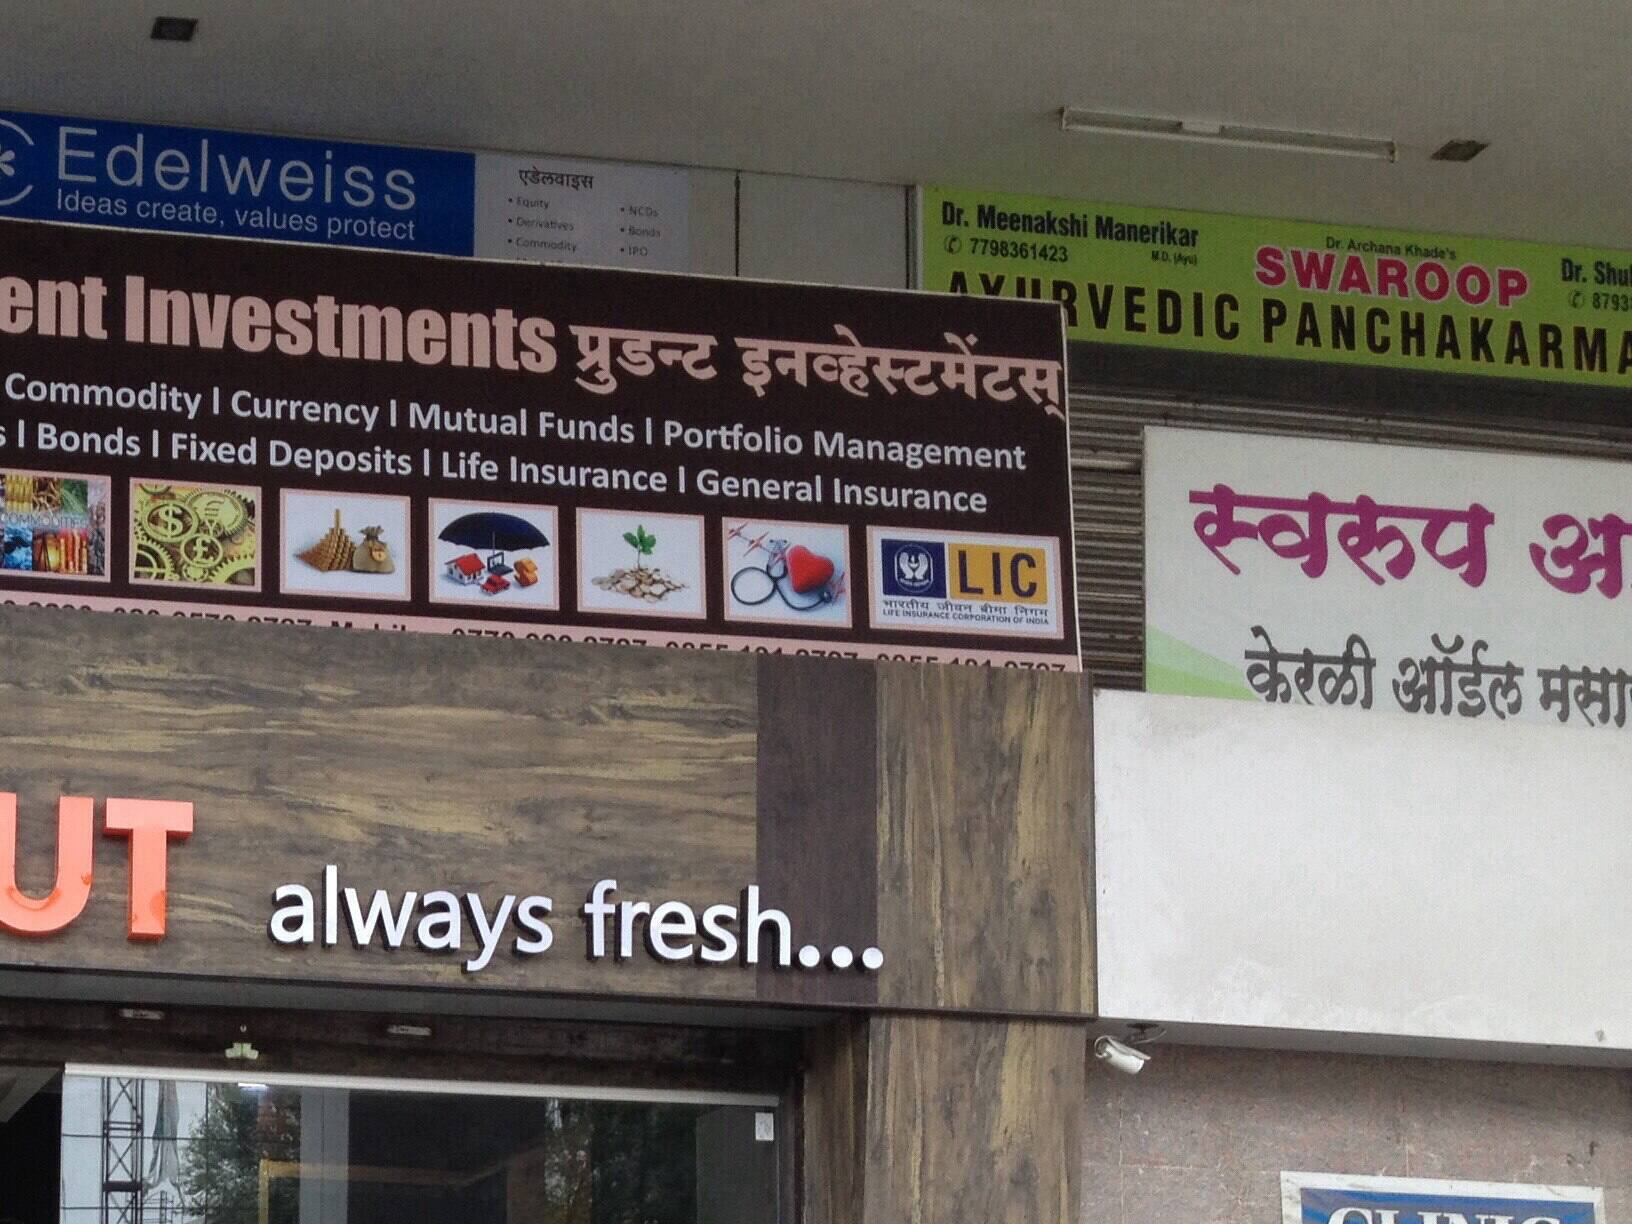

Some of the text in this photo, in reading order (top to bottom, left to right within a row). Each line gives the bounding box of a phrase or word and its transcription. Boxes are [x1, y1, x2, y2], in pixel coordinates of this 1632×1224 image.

[57, 126, 417, 211] Edelweiss
[519, 166, 594, 191] एडेलवाइस
[57, 188, 416, 242] Ideas create, values protect
[517, 197, 550, 209] Equity
[628, 206, 659, 218] NCDs
[517, 217, 574, 231] Derivatives
[628, 226, 661, 238] Bonds
[942, 201, 1199, 247] Dr. Meenakshi Manerikar
[516, 236, 577, 252] Commodity
[628, 246, 648, 257] IPO
[970, 237, 1068, 263] 7798361423
[1326, 236, 1457, 260] Dr. Archana Khade's
[1255, 246, 1529, 309] SWAROOP
[1561, 257, 1587, 283] Dr.
[1592, 292, 1632, 312] 8793
[125, 274, 556, 373] Investments
[1262, 298, 1632, 375] PANCHAKARMA
[5, 371, 201, 419] Commodity
[231, 389, 379, 433] Currency
[408, 401, 527, 439] Mutual
[538, 409, 635, 446] Funds
[664, 418, 803, 457] Portfolio
[814, 430, 1028, 472] Management
[37, 426, 142, 458] Bonds
[172, 432, 257, 466] Fixed
[269, 440, 413, 478] Deposits
[442, 448, 499, 482] Life
[509, 456, 667, 494] Insurance
[696, 468, 823, 503] General
[833, 478, 988, 515] Insurance
[958, 550, 1038, 598] LIC
[883, 609, 1050, 625] LIFE INSURANCE CORPORATION OF INDIA
[1537, 664, 1632, 730] मसा
[268, 863, 554, 973] always
